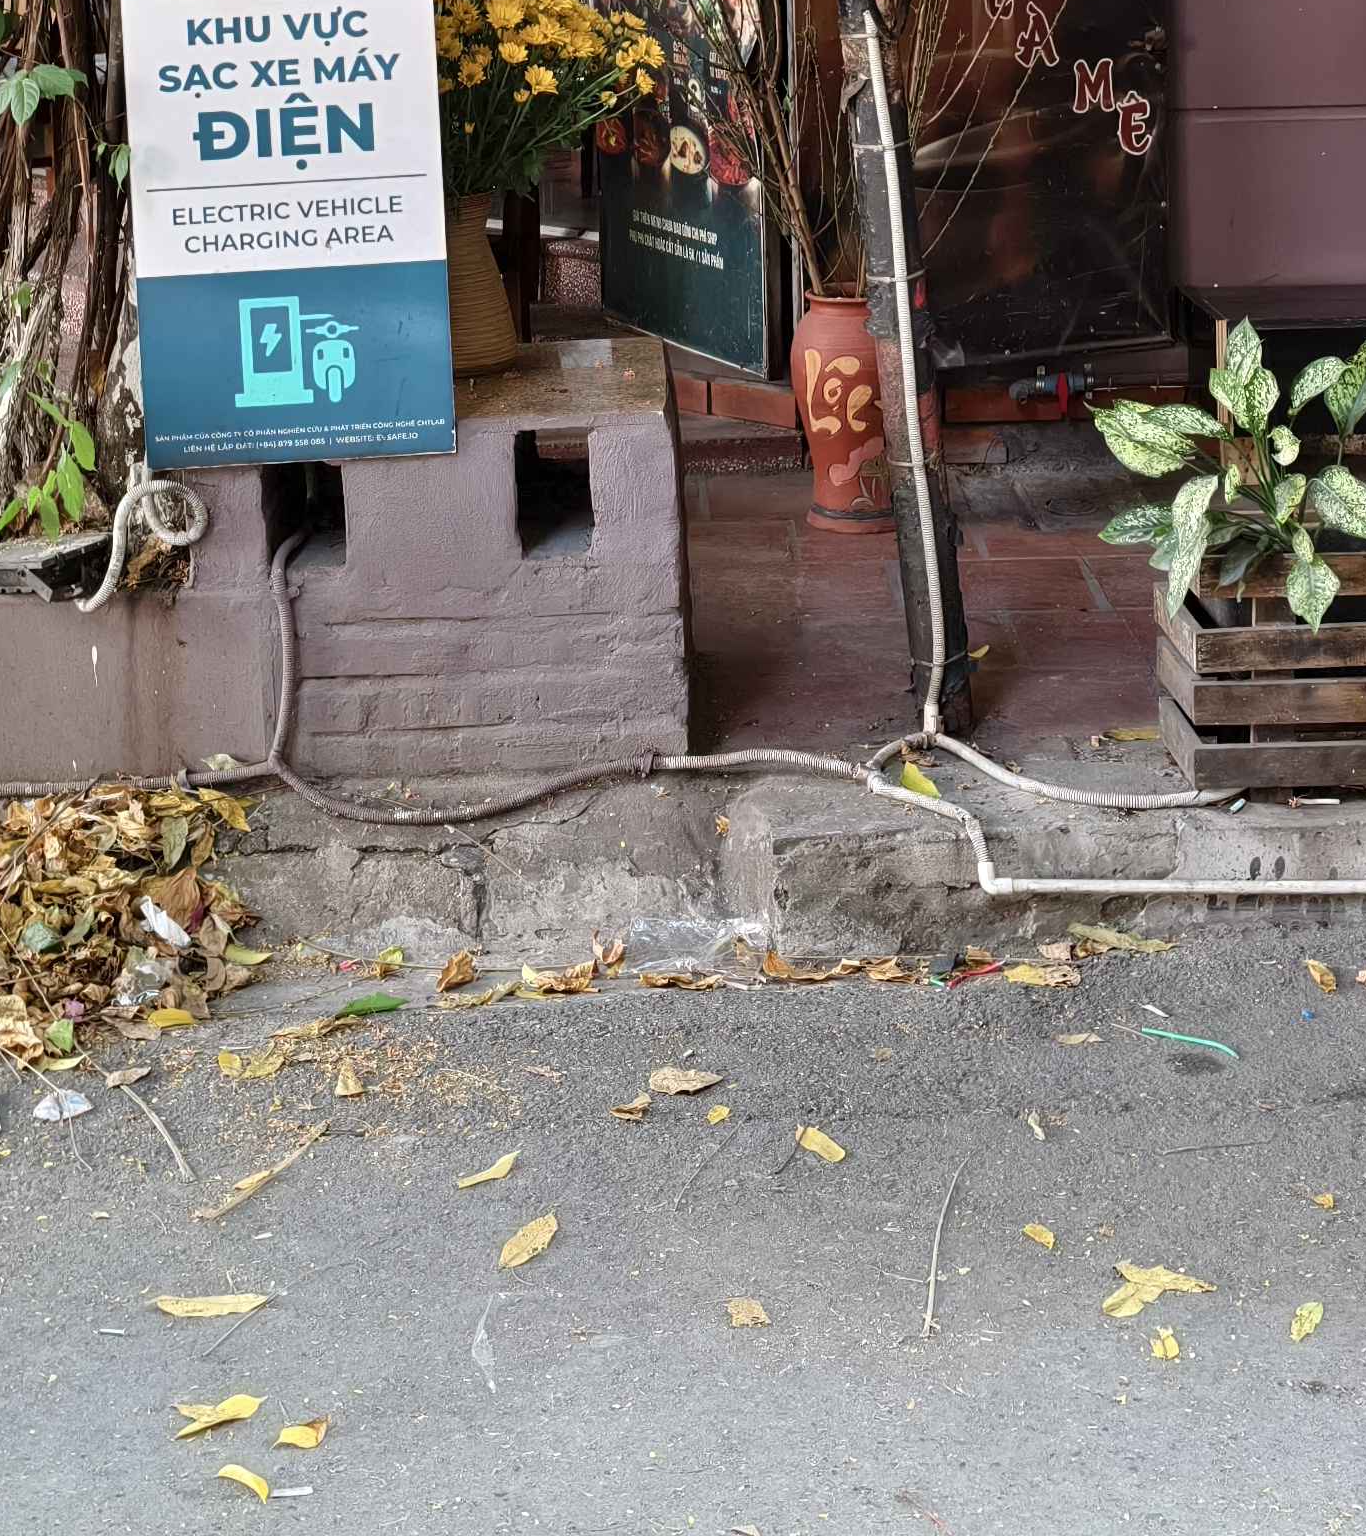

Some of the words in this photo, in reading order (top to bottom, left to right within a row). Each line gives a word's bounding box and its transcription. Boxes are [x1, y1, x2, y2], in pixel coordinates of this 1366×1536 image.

[186, 14, 272, 47] KHU
[283, 6, 370, 48] VỰC
[158, 63, 239, 99] SẠC
[250, 57, 302, 89] XE
[314, 47, 401, 84] MÁY
[192, 92, 376, 171] ĐIỆN
[171, 201, 291, 227] ELECTRIC
[297, 195, 404, 220] VEHICLE
[184, 228, 319, 254] CHARGING
[327, 224, 395, 246] AREA
[183, 443, 202, 453] LIÊN
